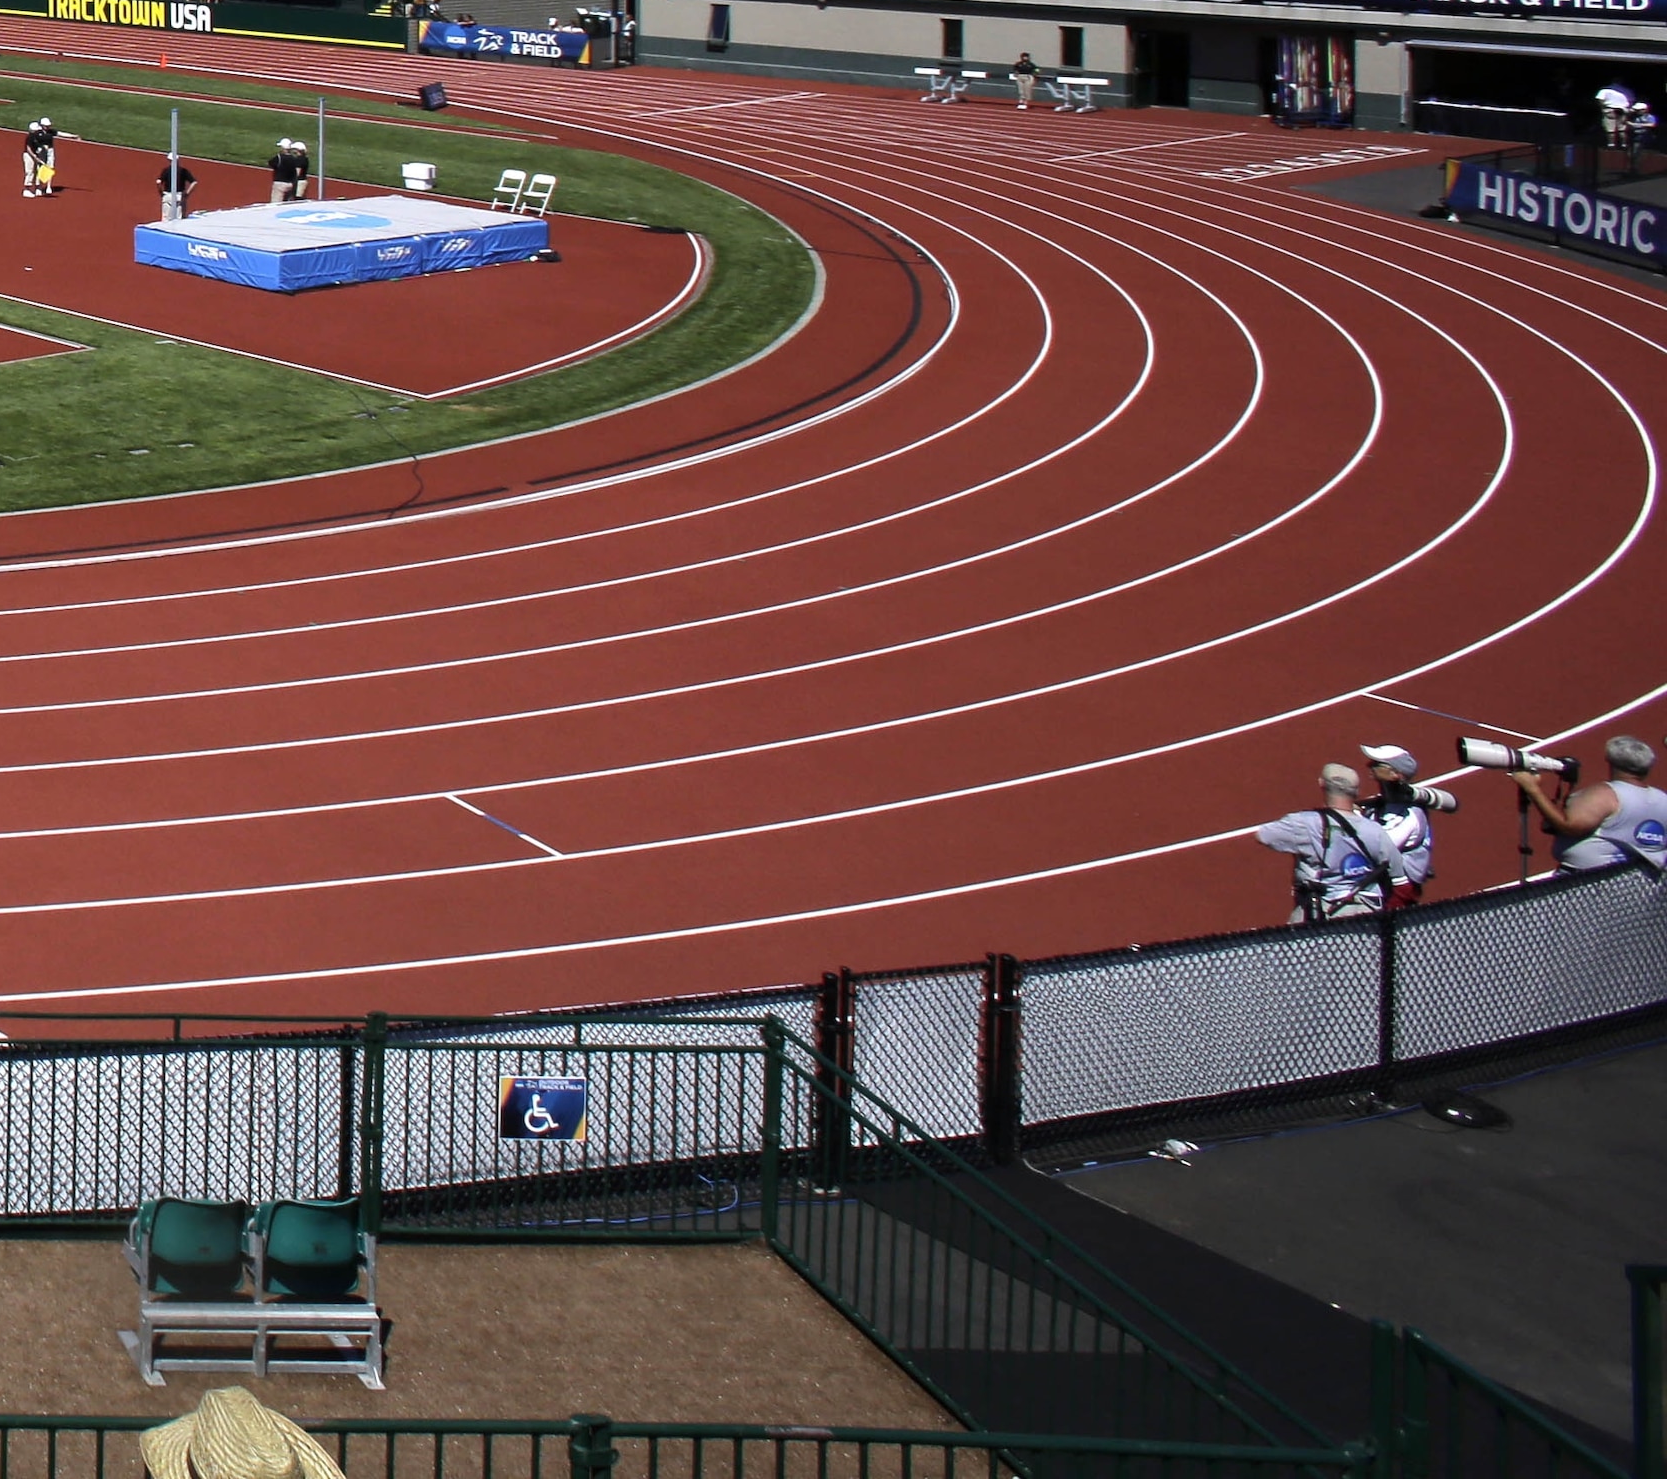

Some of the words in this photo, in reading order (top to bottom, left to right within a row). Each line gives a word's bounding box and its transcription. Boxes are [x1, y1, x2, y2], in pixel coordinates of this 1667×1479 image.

[170, 2, 211, 32] USA
[509, 31, 557, 46] TRACK
[510, 44, 521, 55] &
[522, 45, 562, 58] FIELD
[1478, 171, 1656, 254] HISTORIC
[1636, 831, 1664, 842] NCAA
